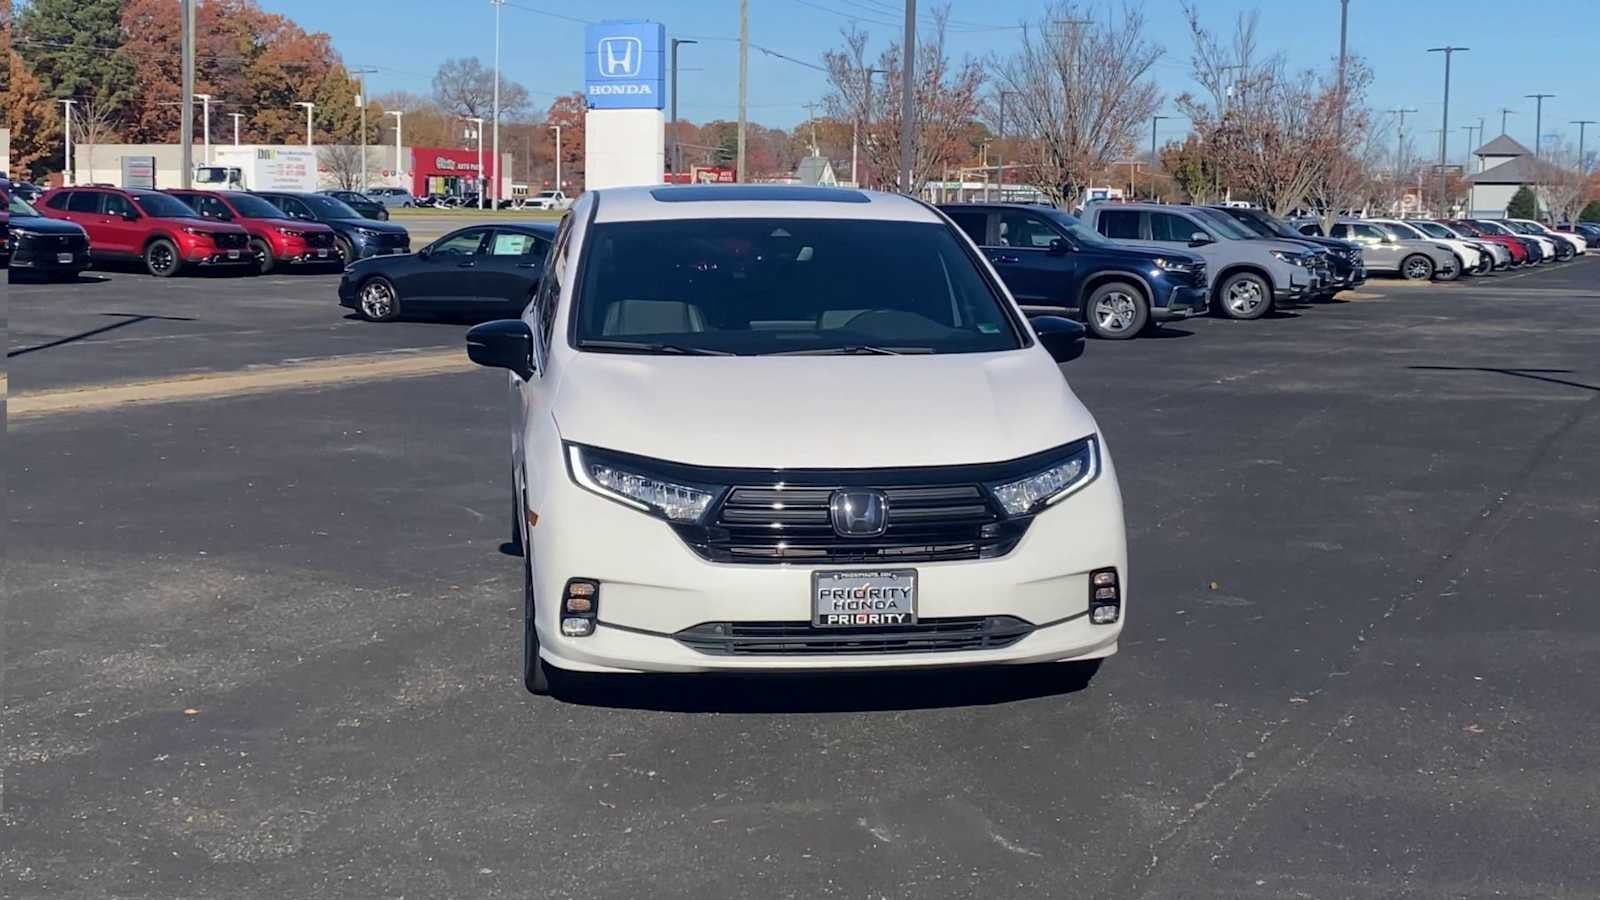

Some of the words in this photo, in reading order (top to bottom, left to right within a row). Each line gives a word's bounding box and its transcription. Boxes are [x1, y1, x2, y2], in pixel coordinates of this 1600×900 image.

[589, 84, 652, 95] HONDA
[819, 586, 911, 600] PRIORITY
[833, 600, 898, 611] HONDA
[827, 613, 905, 625] PRIORITY
